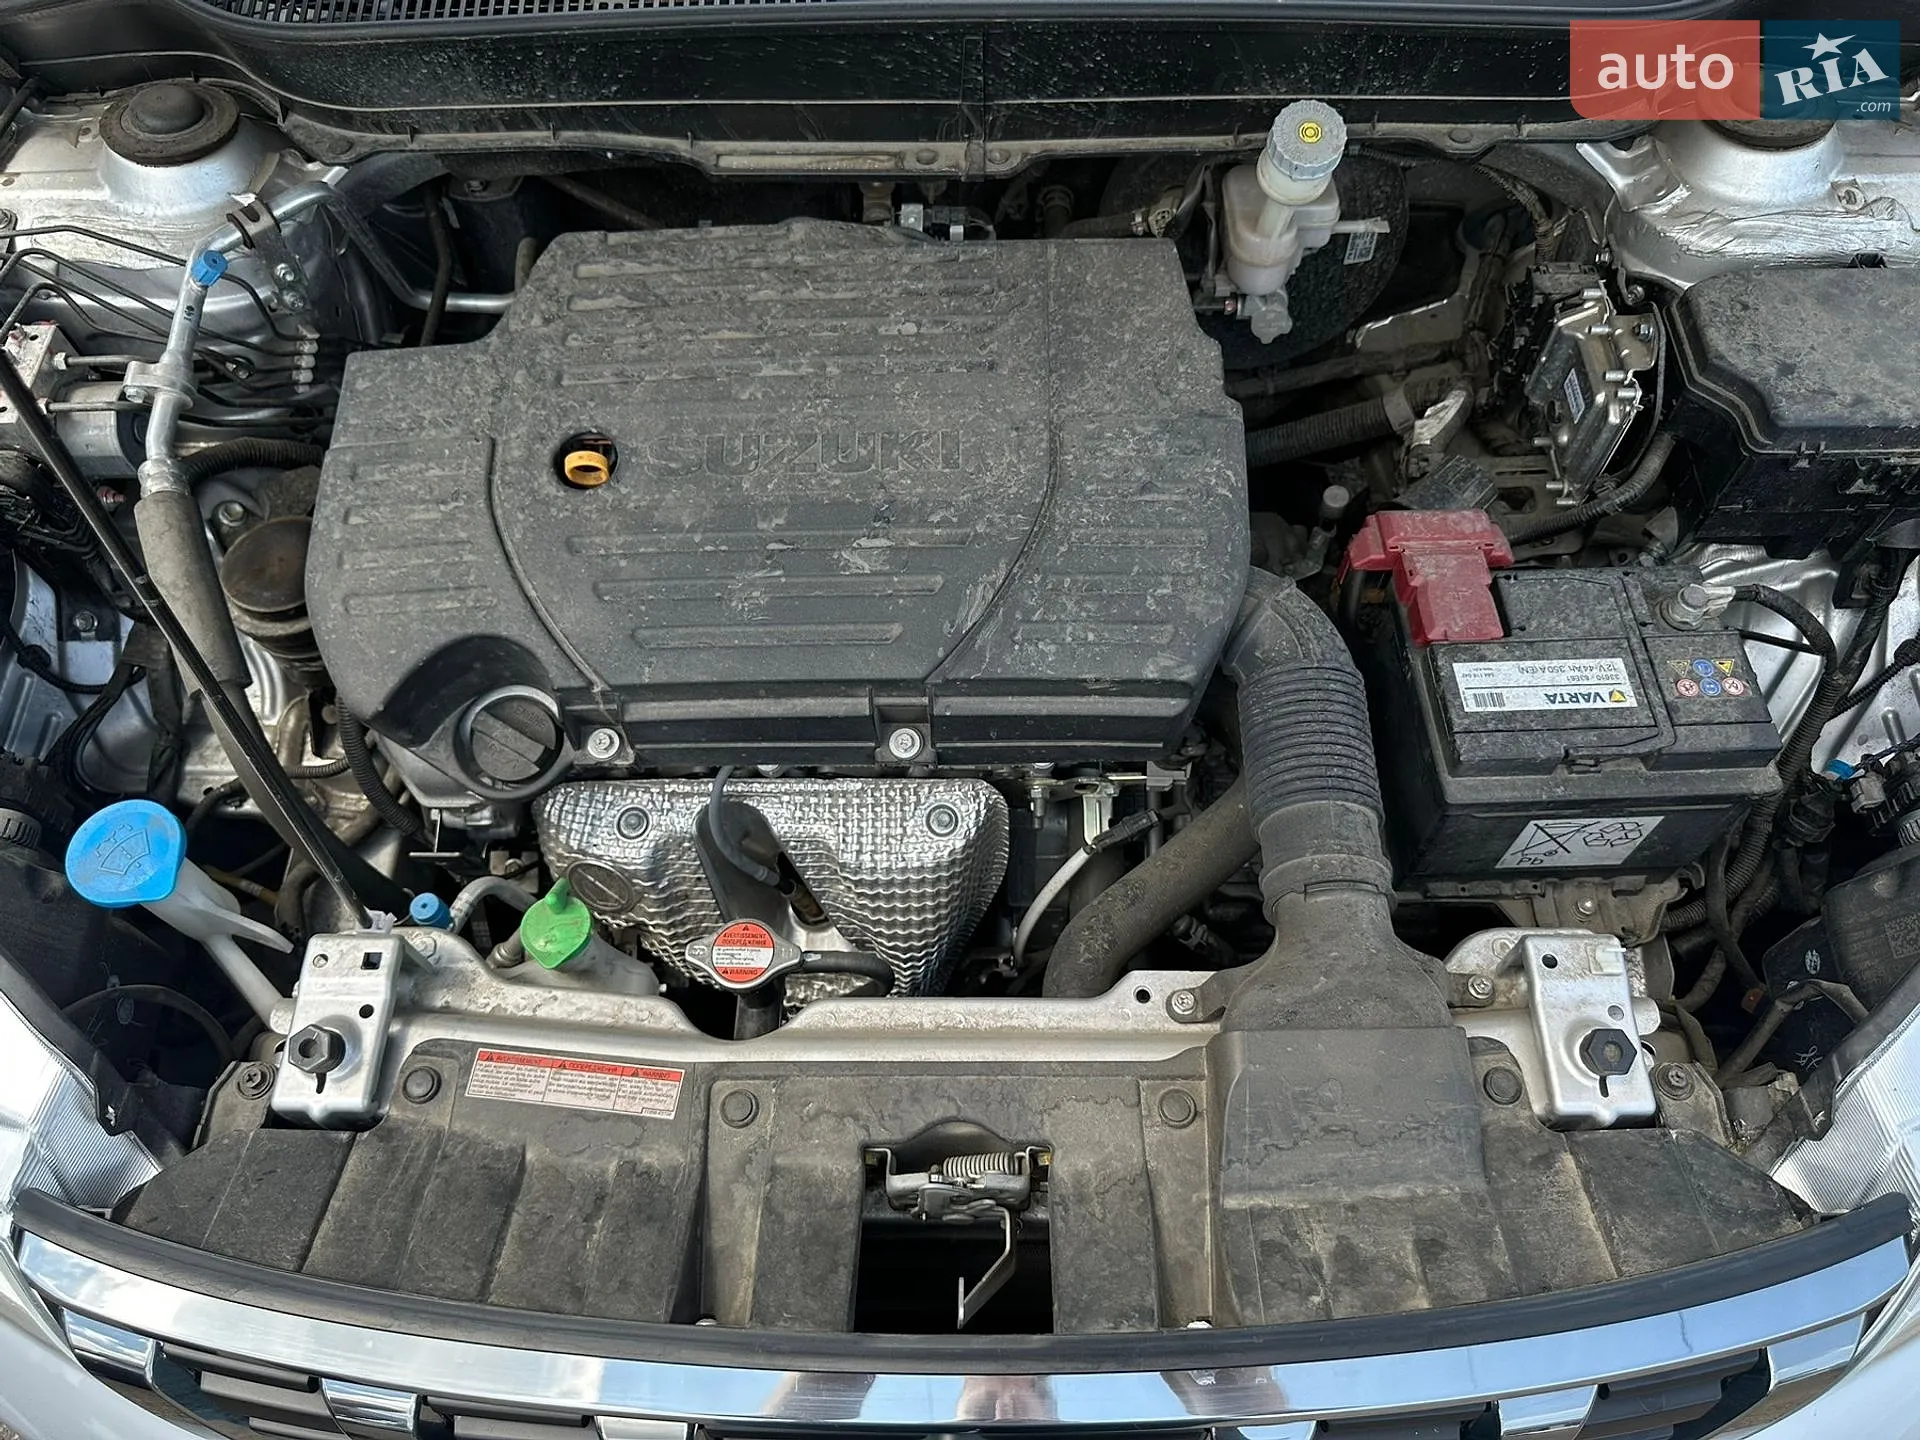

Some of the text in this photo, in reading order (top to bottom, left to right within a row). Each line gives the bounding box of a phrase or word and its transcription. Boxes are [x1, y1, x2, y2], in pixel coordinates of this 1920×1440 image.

[645, 428, 962, 477] SUZUKI
[1544, 692, 1606, 705] VARTA
[1516, 856, 1544, 866] Pb
